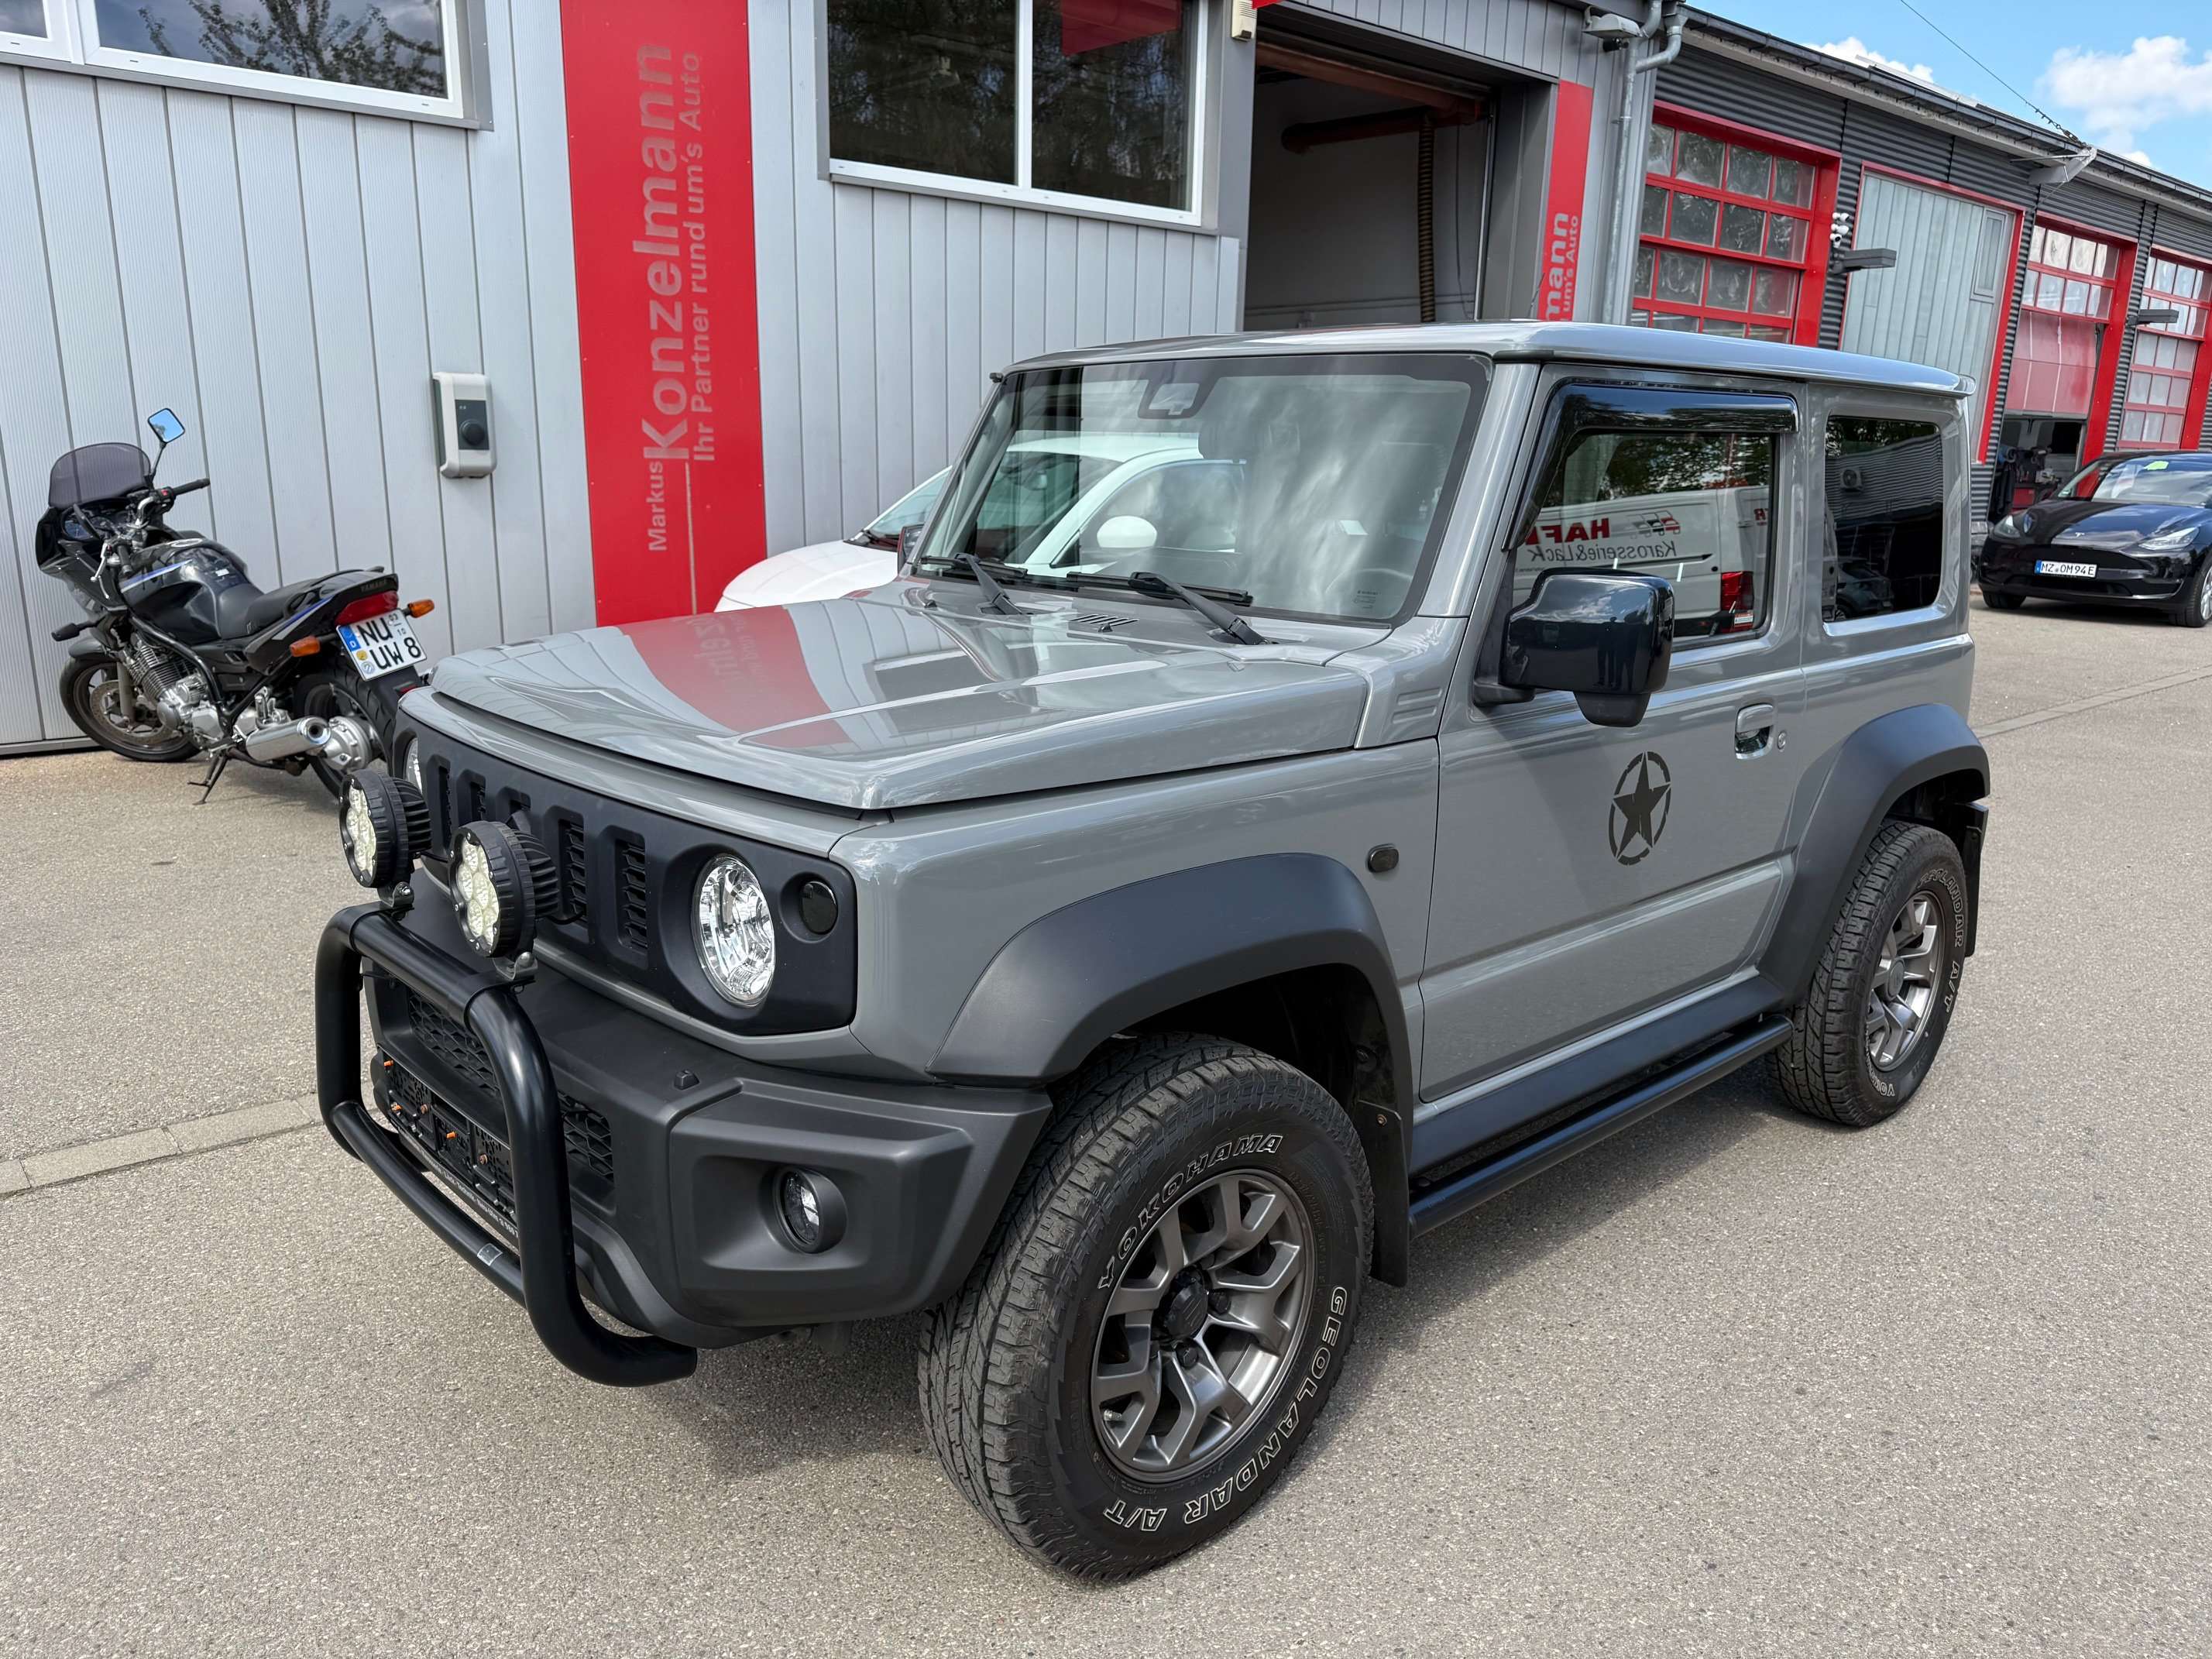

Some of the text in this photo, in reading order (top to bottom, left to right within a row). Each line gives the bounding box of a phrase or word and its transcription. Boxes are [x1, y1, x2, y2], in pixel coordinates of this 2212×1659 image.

[678, 53, 702, 132] Auto
[684, 220, 709, 294] rund
[1565, 215, 1579, 264] Auto
[633, 43, 689, 551] Markus Konzelmann
[690, 302, 713, 415] Partner
[693, 421, 715, 462] Ihr
[356, 617, 393, 646] NU
[369, 637, 421, 670] UW 8
[1097, 1132, 1284, 1290] YOKOHAMA
[1103, 1286, 1348, 1532] GEOLANDAR A/T
